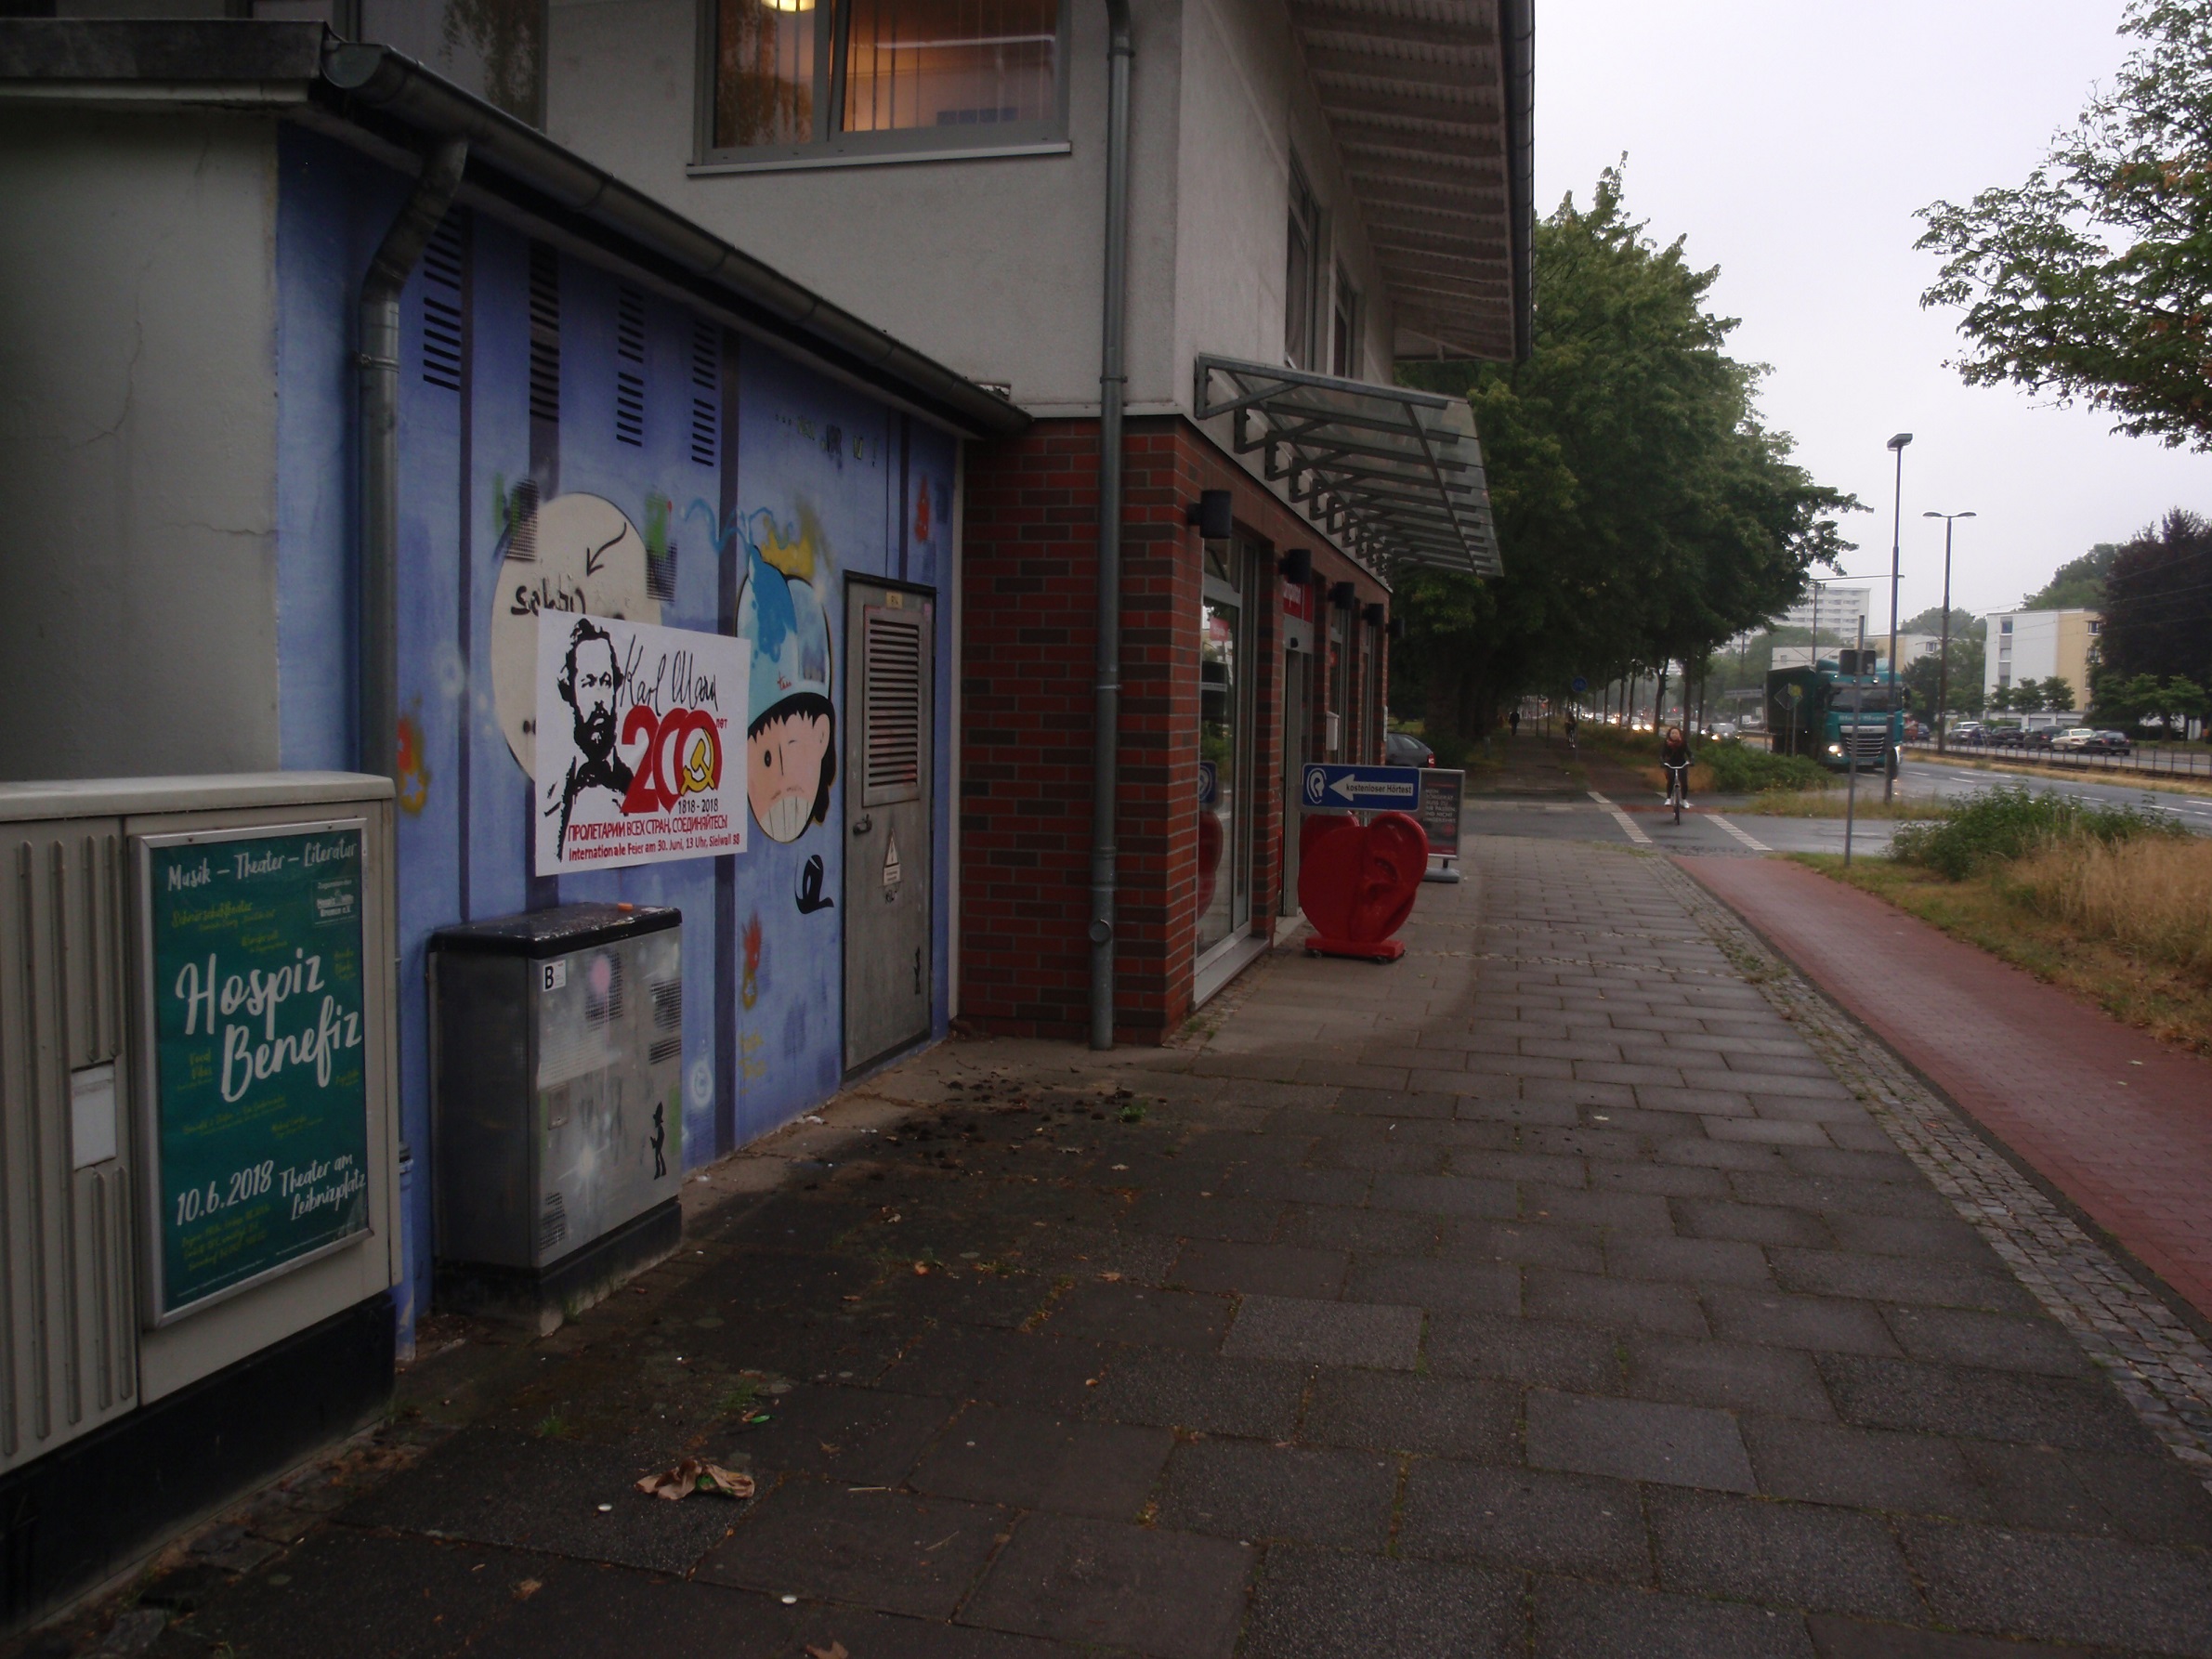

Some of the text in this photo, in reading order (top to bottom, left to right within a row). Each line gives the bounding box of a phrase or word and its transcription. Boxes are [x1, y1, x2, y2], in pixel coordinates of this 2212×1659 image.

[620, 705, 723, 815] 200
[678, 800, 696, 814] 1818
[701, 798, 719, 813] 2018
[1346, 783, 1412, 794] kostenloser Hörtest
[569, 833, 740, 862] Internationale Feier am 30. Juni, 13 Uhr, Sielwall 38
[626, 819, 646, 836] ВСЕХ
[167, 857, 212, 892] Musik
[233, 850, 285, 880] Theater
[304, 838, 357, 868] Literatur
[175, 947, 325, 1041] Hospiz
[544, 965, 554, 990] B
[220, 995, 361, 1103] Benefiz
[177, 1154, 353, 1226] 10.6.2018 Theater am
[290, 1168, 366, 1221] Leibnizplatz
